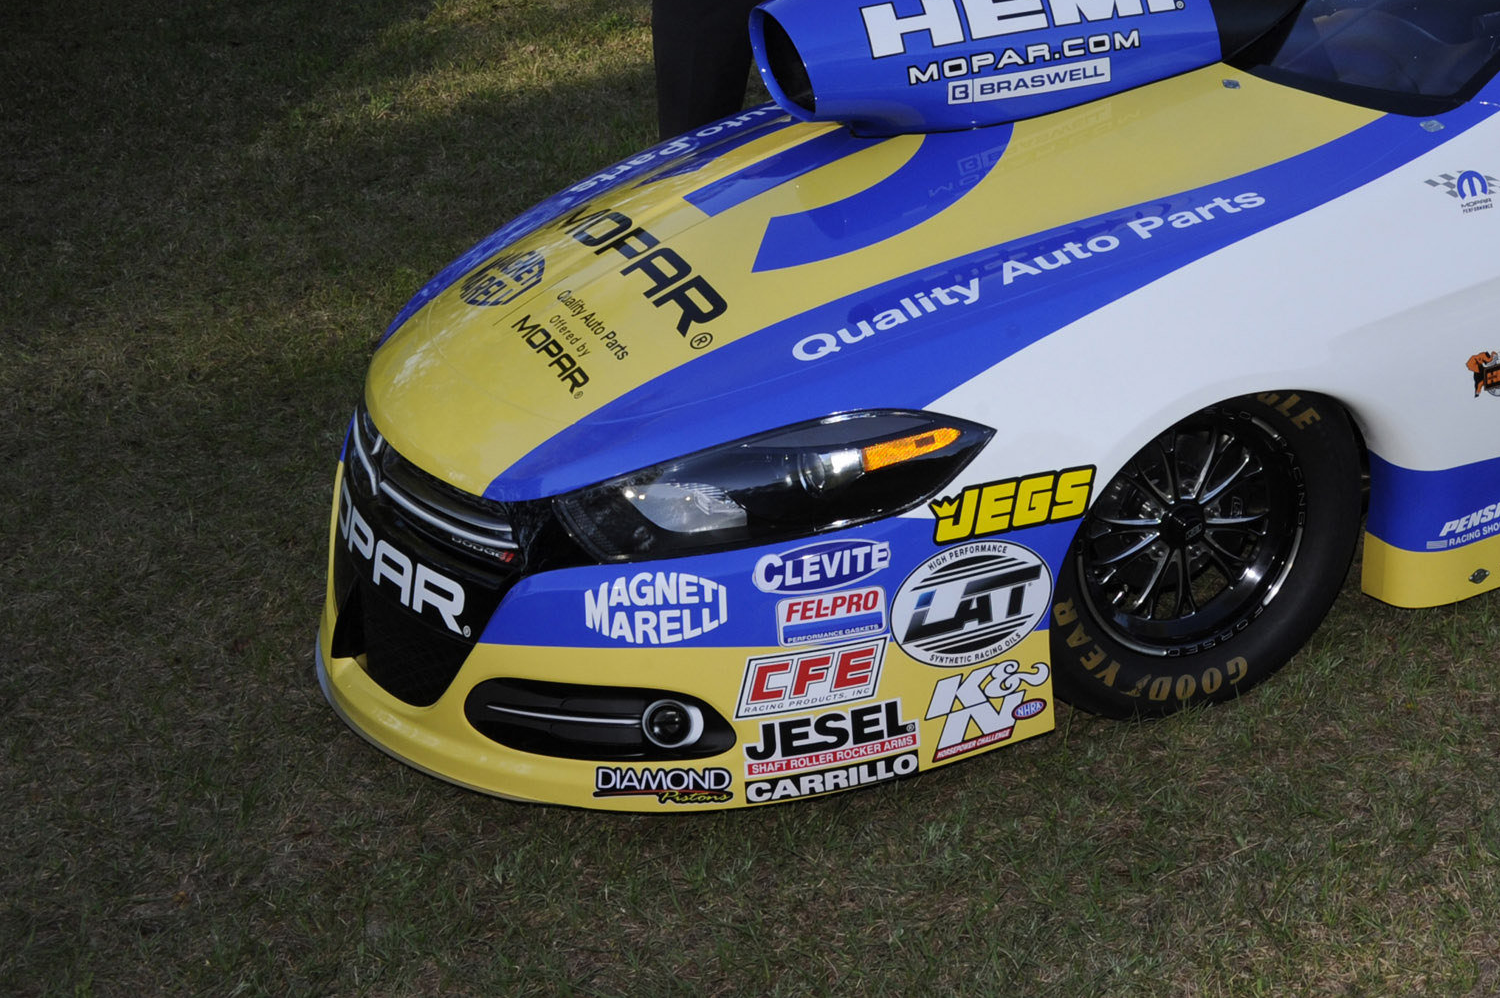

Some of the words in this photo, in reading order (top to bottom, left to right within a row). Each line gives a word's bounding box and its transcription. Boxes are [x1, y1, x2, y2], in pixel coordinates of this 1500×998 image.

[907, 30, 1142, 86] MOPAR.COM
[979, 65, 1106, 97] BRASWELL
[1461, 197, 1492, 209] MOPAR
[1462, 202, 1494, 215] PERFORMANCE
[791, 277, 982, 362] Quality
[1001, 234, 1121, 285] Auto
[1126, 190, 1267, 240] Parts
[556, 289, 585, 319] Quality
[581, 312, 606, 336] Auto
[602, 330, 629, 361] Parts
[935, 468, 1094, 543] JEGS
[1449, 529, 1482, 547] RACING
[754, 541, 890, 591] CLEVITE
[926, 555, 948, 571] HIGH
[948, 544, 1009, 560] PERFORMANCE
[584, 571, 728, 626] MAGNETI
[785, 590, 879, 623] FEL-PRO
[584, 600, 728, 644] MARELLI
[786, 629, 844, 644] PERFORMANCE
[845, 624, 879, 636] GASKETS
[929, 653, 973, 665] SYNTHETIC
[974, 644, 1004, 661] RACING
[1004, 631, 1022, 648] OILS
[750, 647, 876, 702] CFE
[743, 703, 784, 714] RACING
[1015, 700, 1046, 717] NHRA
[752, 760, 788, 775] SHAFT
[790, 750, 834, 768] ROLLER
[836, 743, 882, 760] ROCKER
[883, 736, 914, 751] ARMS
[596, 768, 731, 791] DIAMOND
[746, 753, 919, 802] CARRILLO
[659, 790, 730, 804] Pistons
